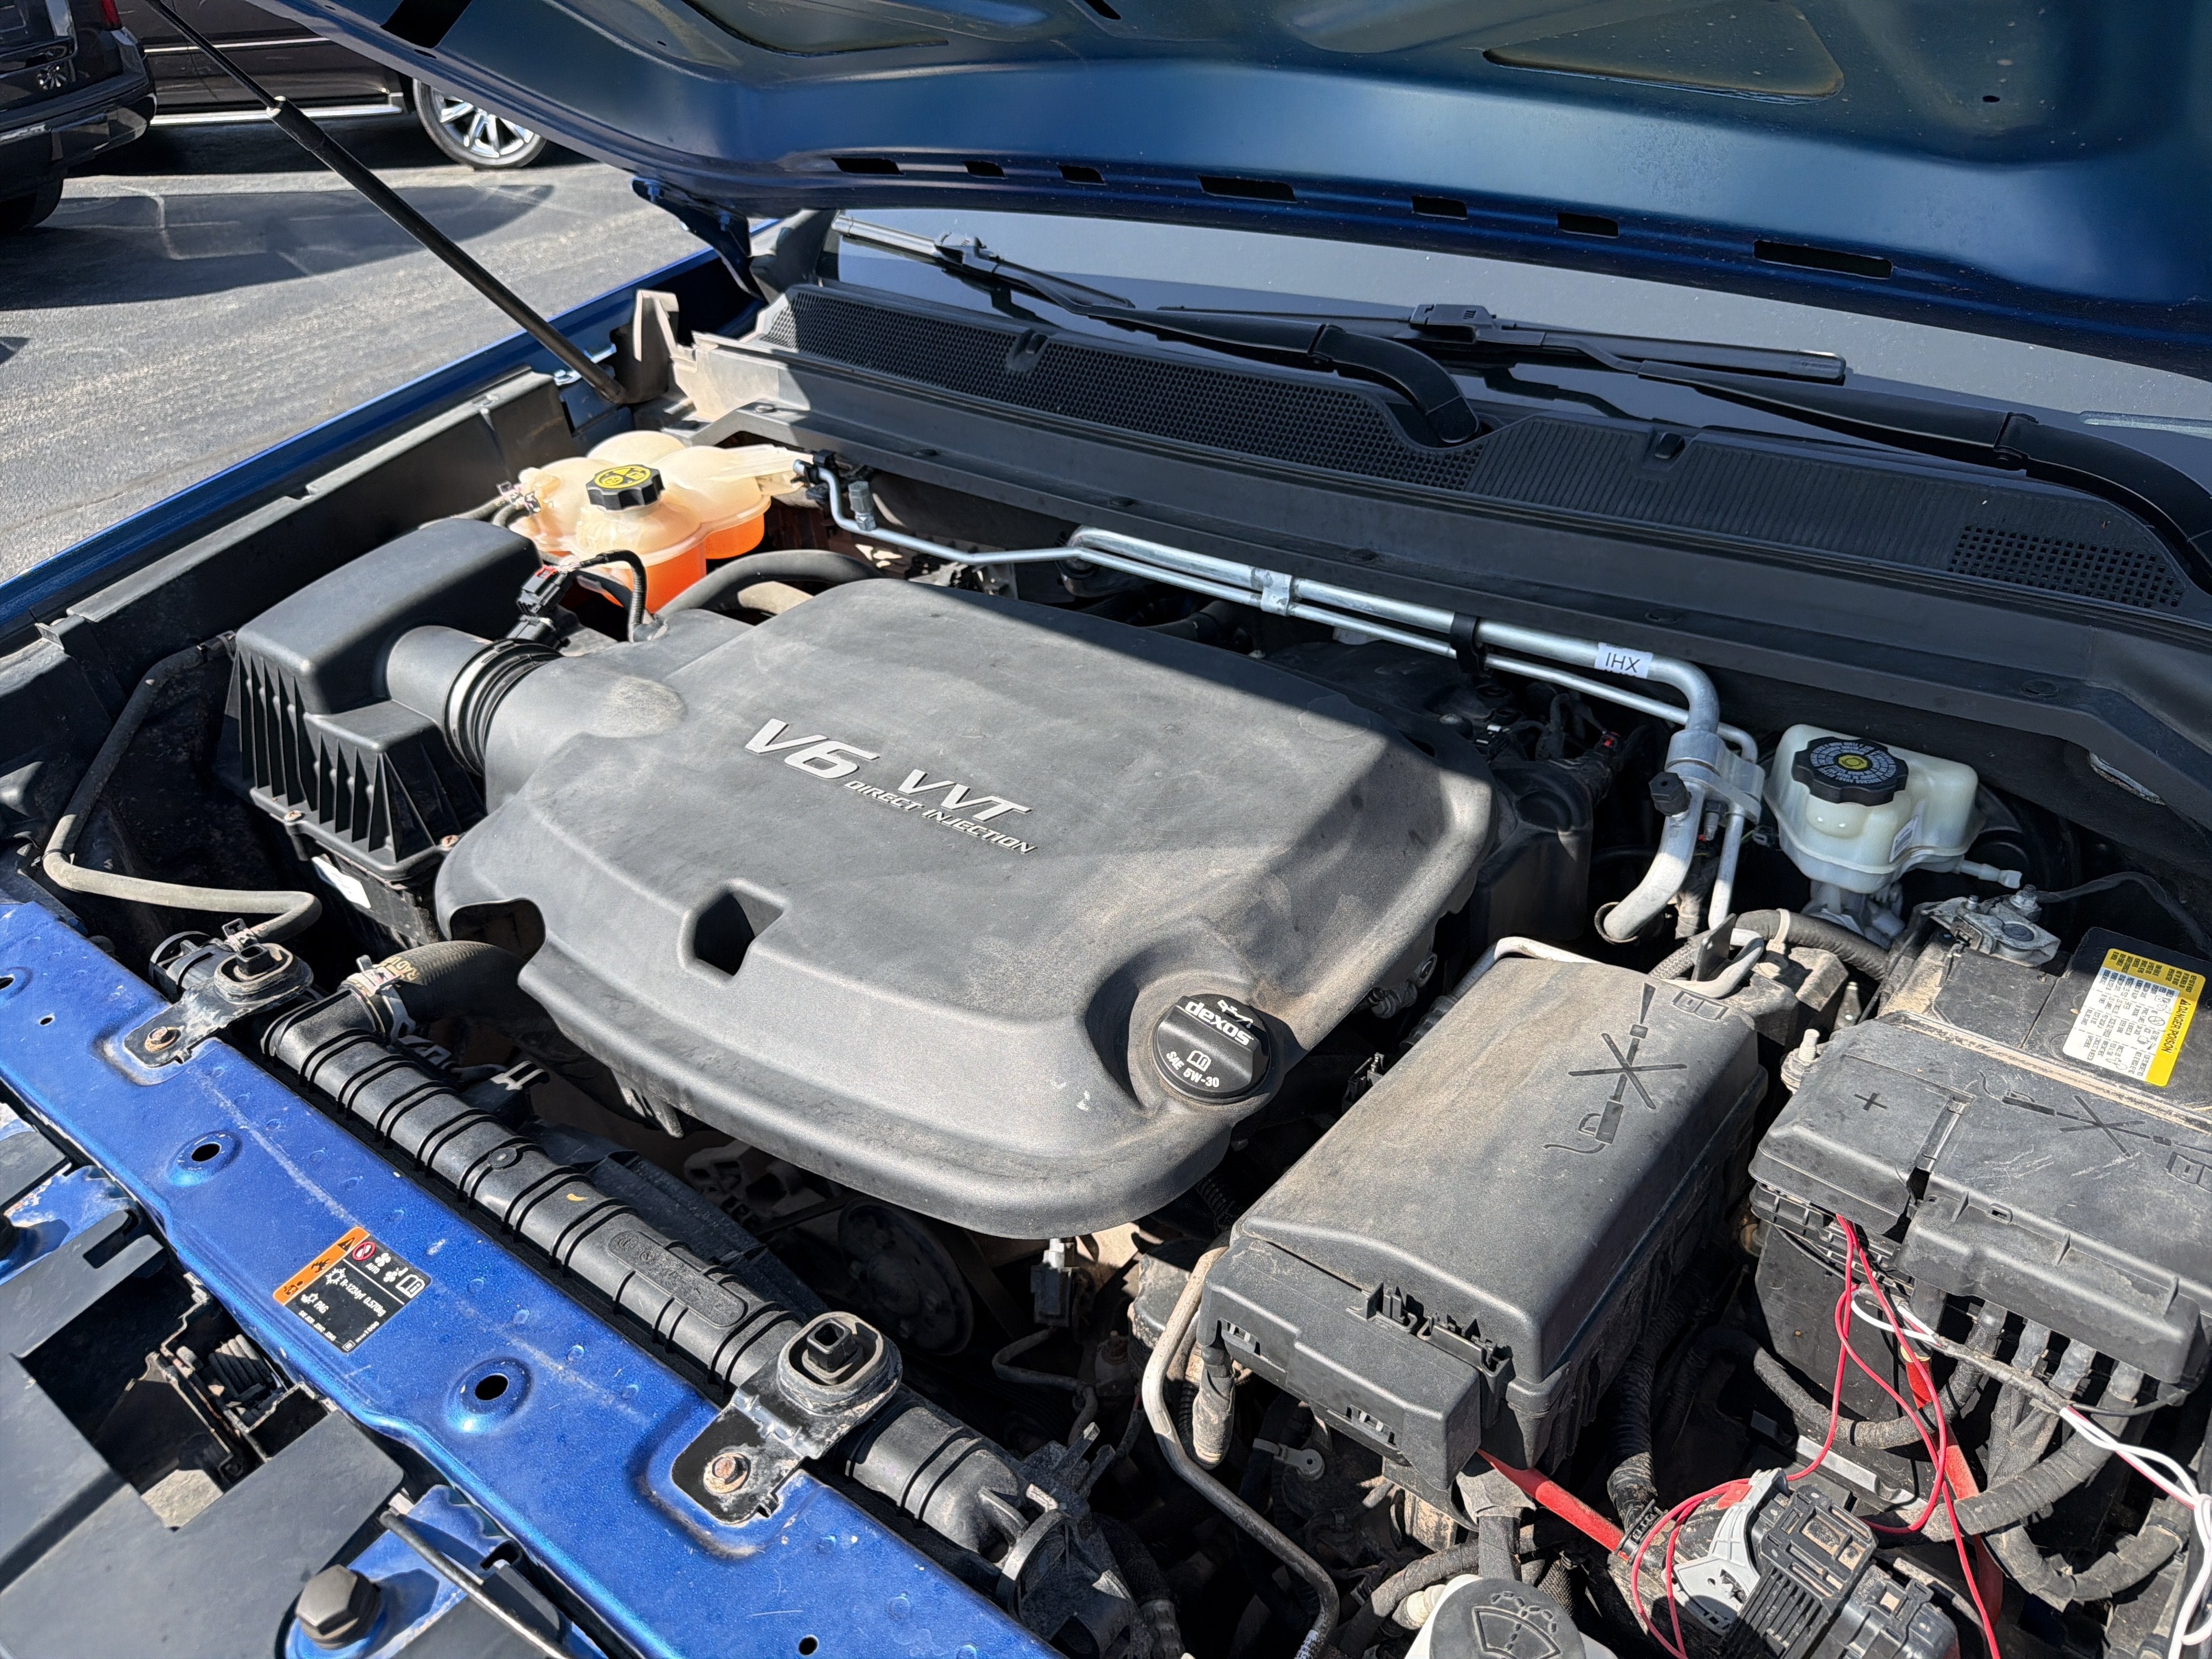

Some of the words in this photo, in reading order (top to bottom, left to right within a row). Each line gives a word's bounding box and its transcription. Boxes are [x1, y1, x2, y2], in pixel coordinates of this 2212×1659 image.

[1605, 652, 1641, 673] IHX
[744, 718, 881, 781] V6
[898, 768, 1032, 822] VVT
[844, 780, 925, 811] DIRECT
[922, 809, 1038, 854] INJECTION
[1185, 1001, 1252, 1046] dexos
[1166, 1051, 1185, 1070] SAE
[1183, 1067, 1220, 1088] 5W-30
[365, 1262, 381, 1274] AUTO
[339, 1278, 367, 1300] R-1234yf
[313, 1300, 329, 1314] PAG
